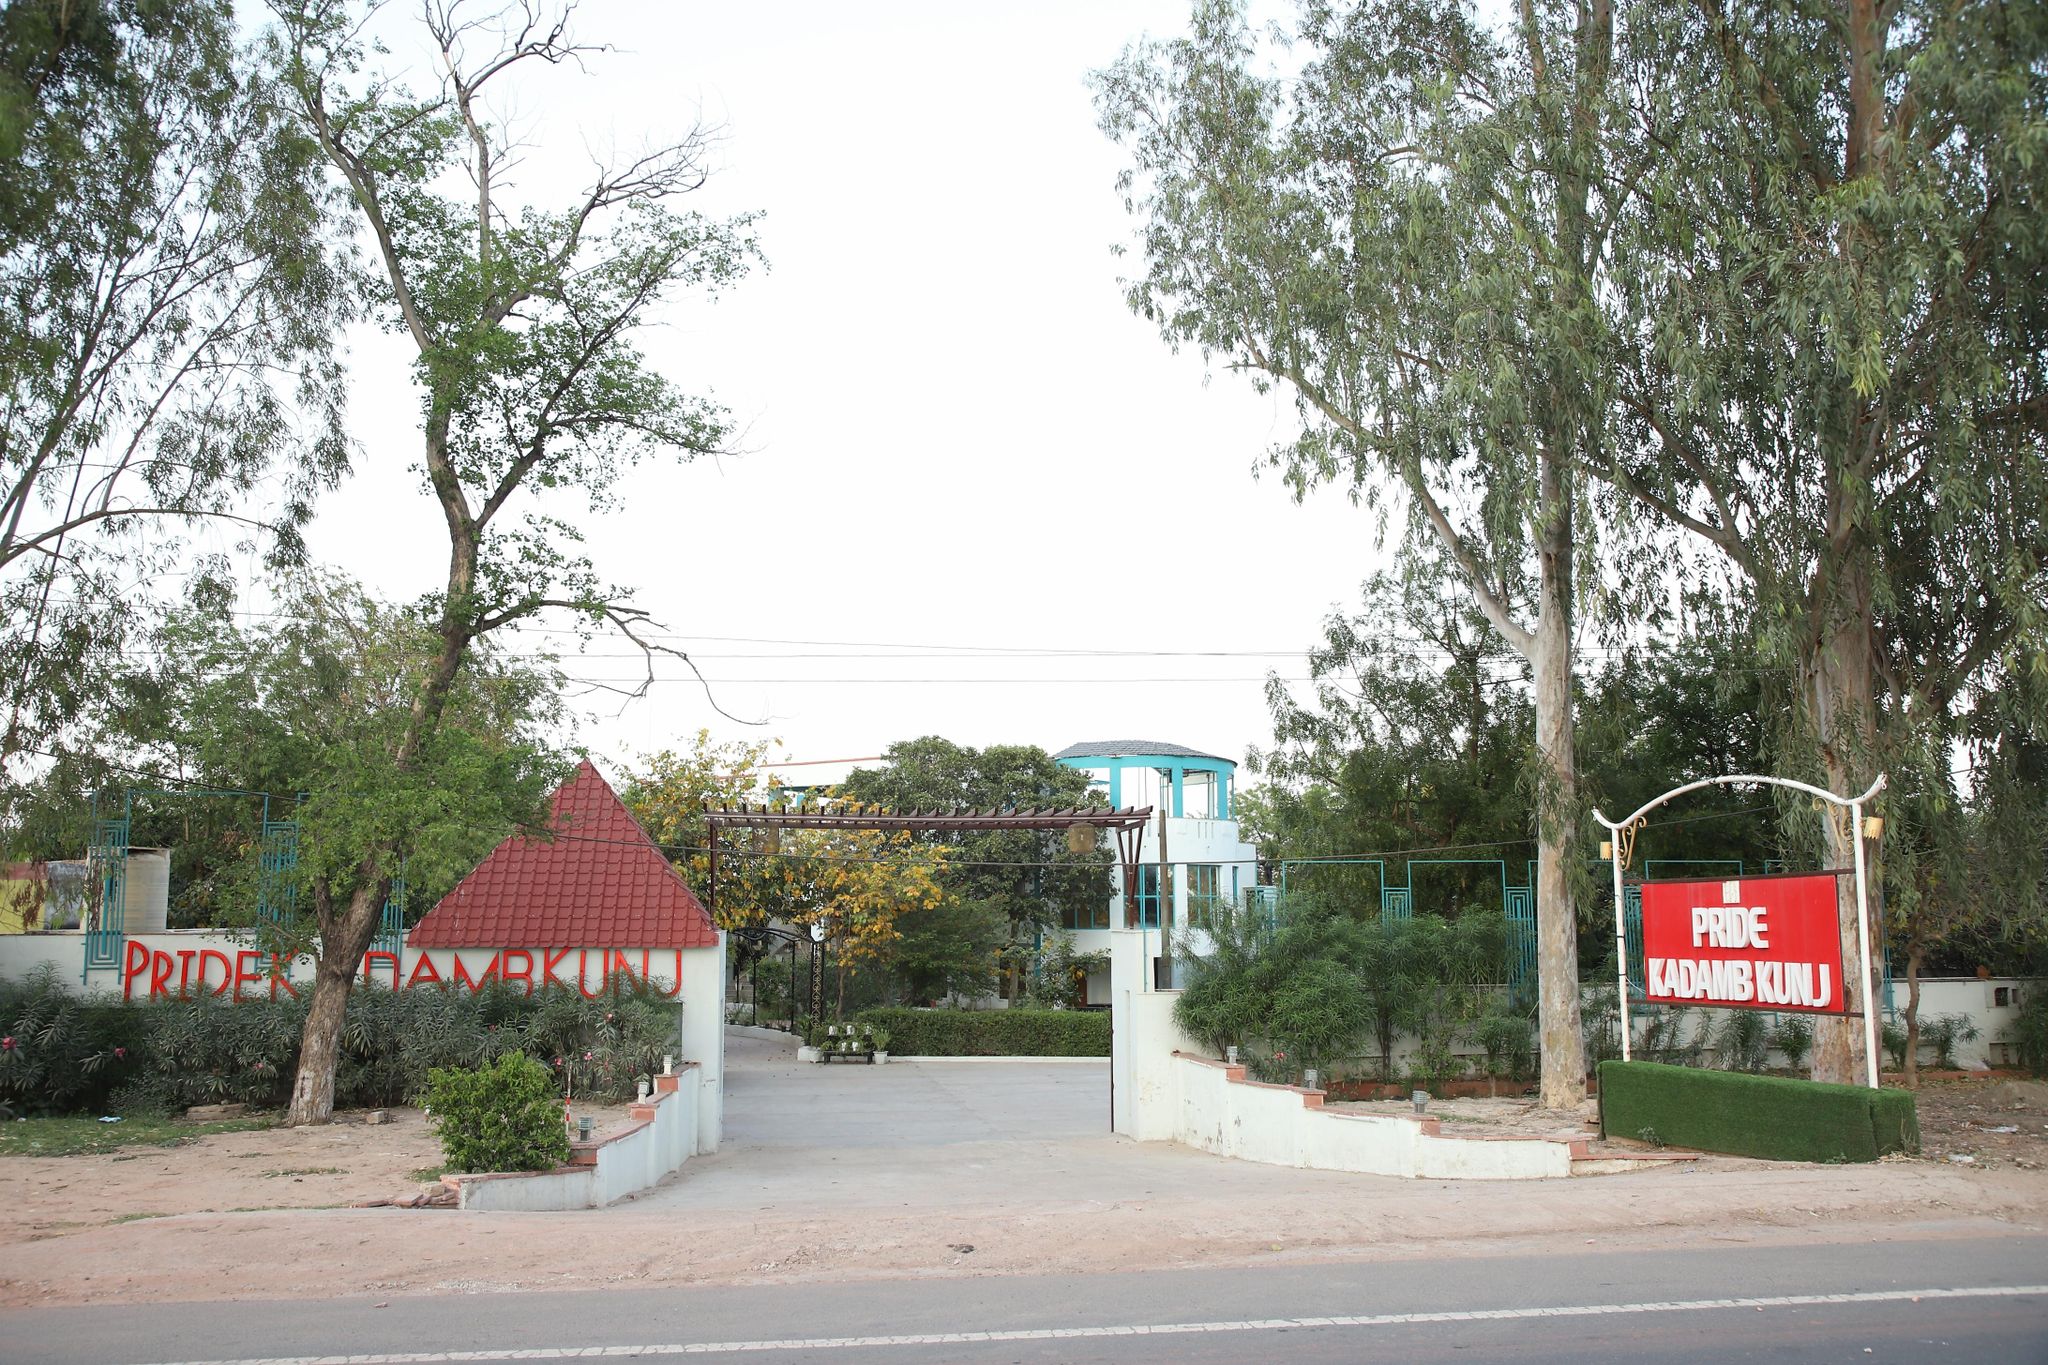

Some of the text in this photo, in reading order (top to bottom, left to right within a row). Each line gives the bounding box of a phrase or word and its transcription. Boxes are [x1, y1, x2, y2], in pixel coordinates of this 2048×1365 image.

[1692, 906, 1769, 949] PRIDE
[123, 940, 262, 1004] PRIDE
[1648, 957, 1831, 1008] KADAMB KUNJ
